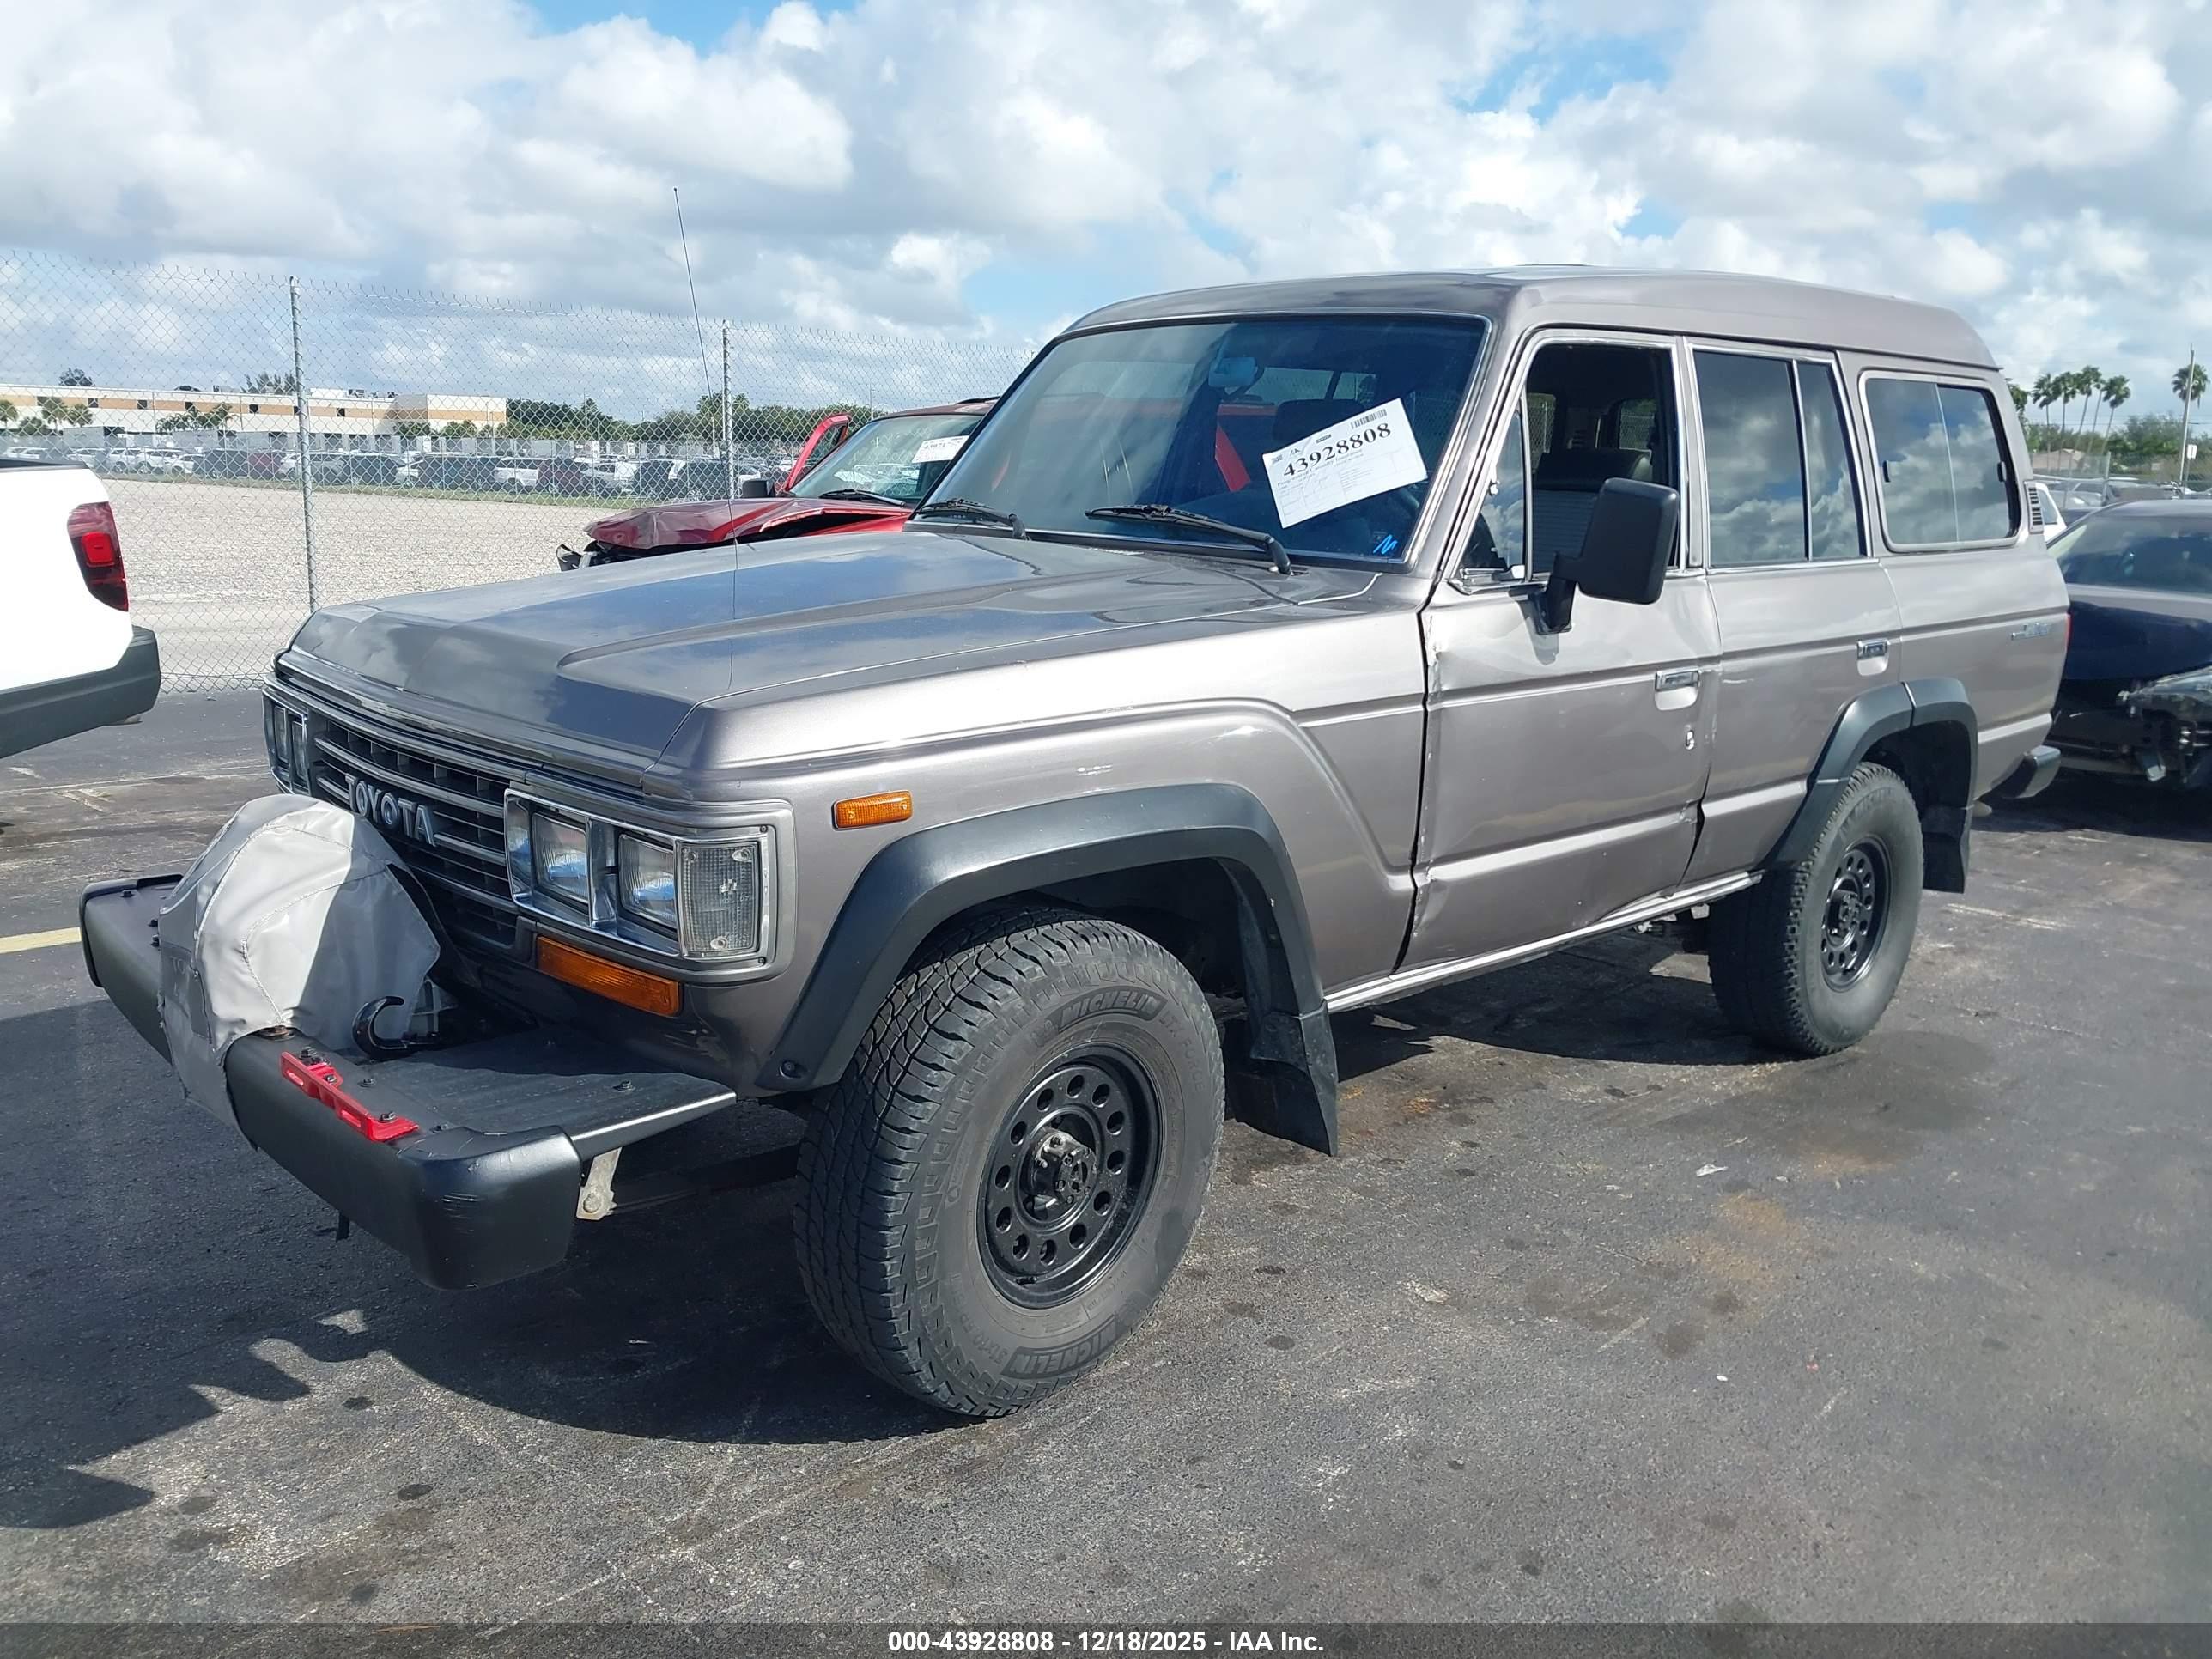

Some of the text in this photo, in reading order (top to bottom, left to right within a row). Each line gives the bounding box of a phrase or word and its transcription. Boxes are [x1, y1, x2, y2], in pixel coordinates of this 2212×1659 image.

[1283, 422, 1391, 477] 43928808
[345, 773, 436, 847] TOYOTA
[1060, 990, 1159, 1027] MICHELIN
[1009, 1322, 1116, 1374] MICHELIN
